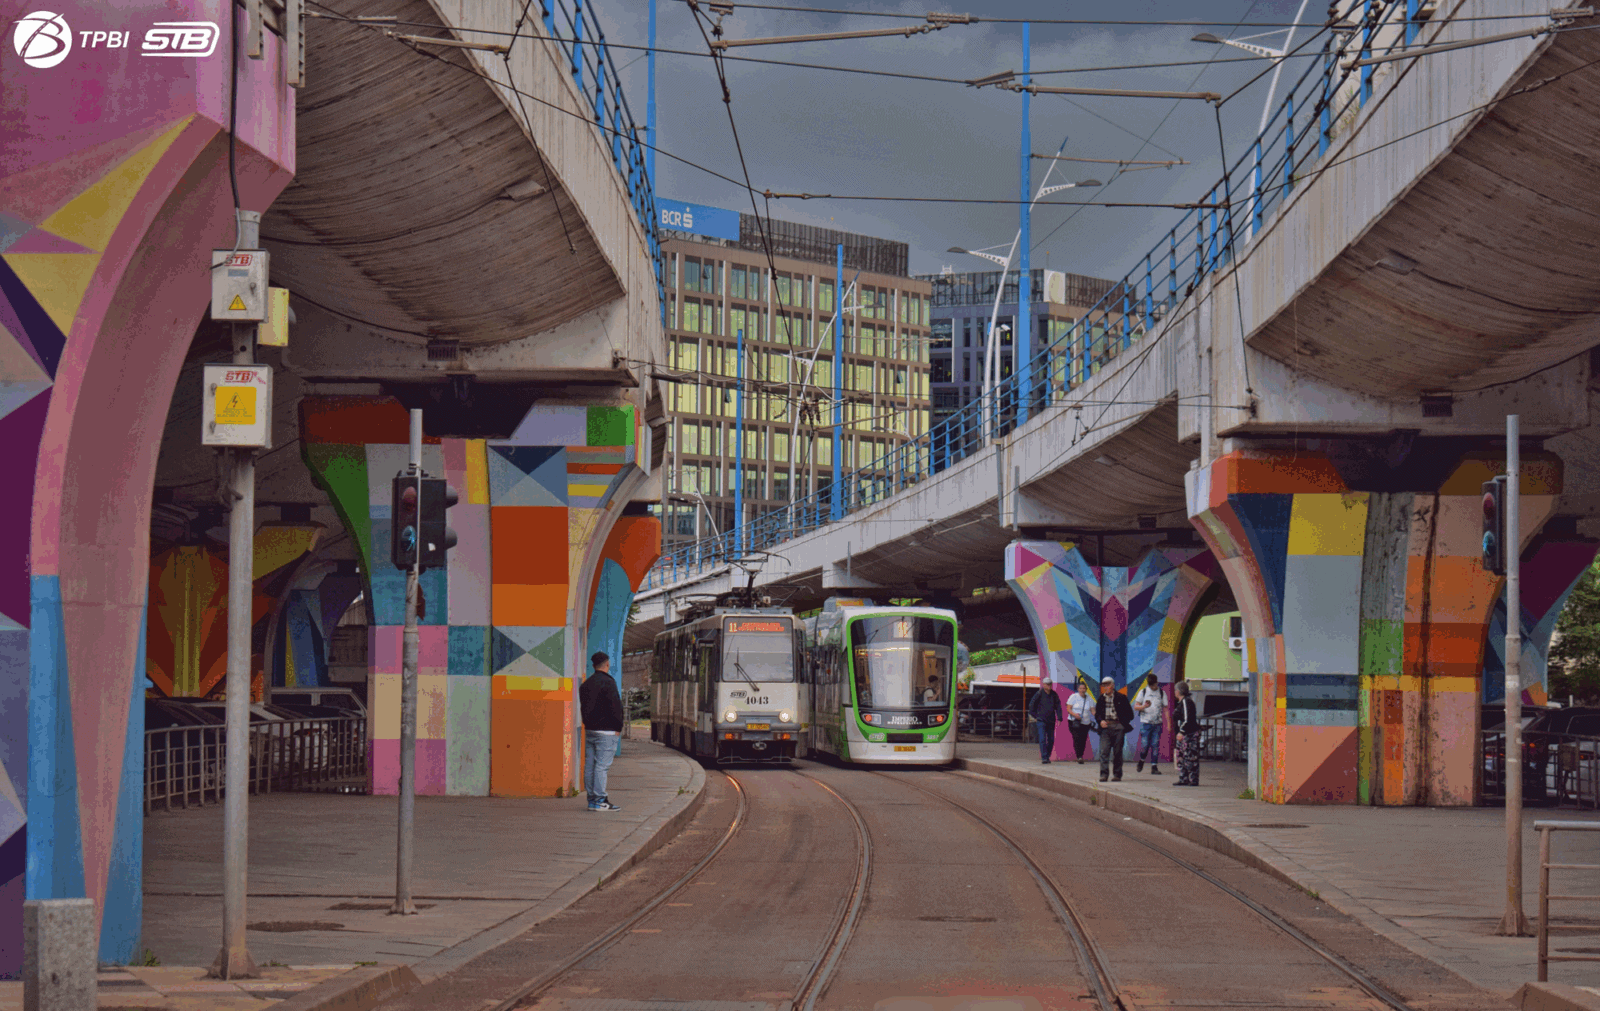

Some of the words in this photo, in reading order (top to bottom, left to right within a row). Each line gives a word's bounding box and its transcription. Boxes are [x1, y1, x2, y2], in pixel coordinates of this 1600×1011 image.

[661, 209, 682, 227] BCR
[225, 255, 251, 265] STB
[225, 371, 251, 382] STB
[744, 696, 769, 705] 4043
